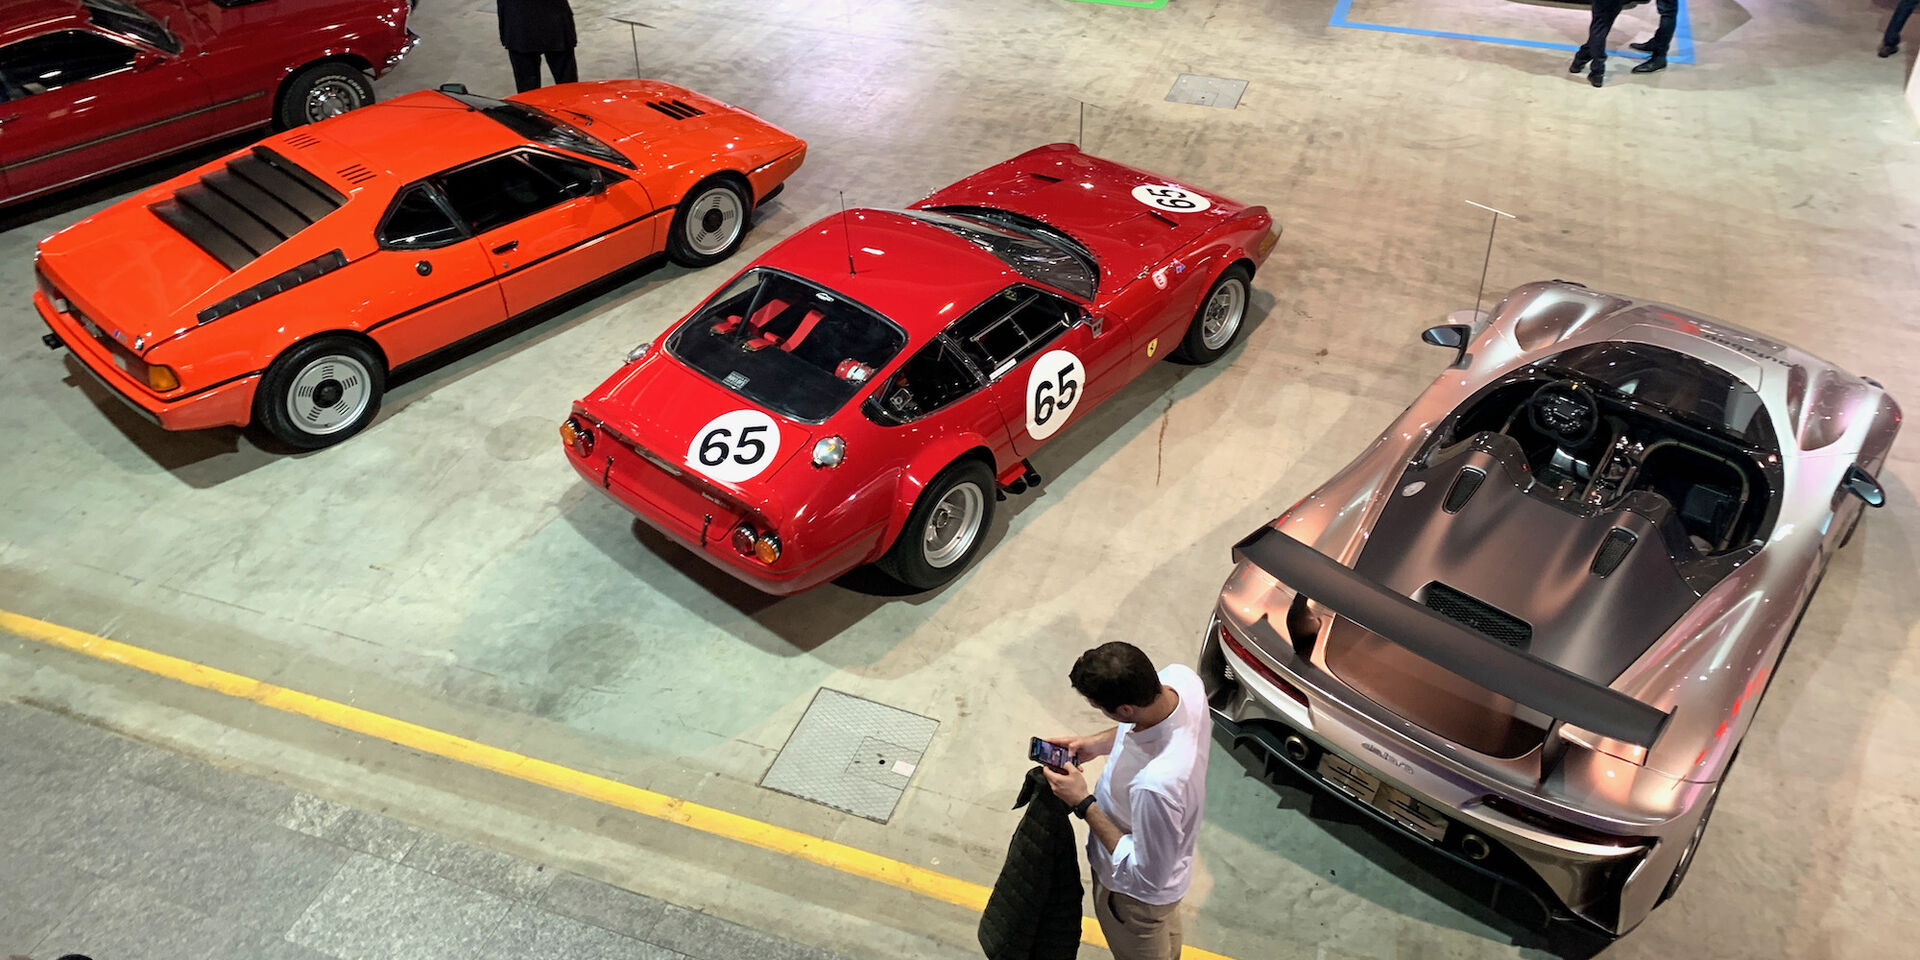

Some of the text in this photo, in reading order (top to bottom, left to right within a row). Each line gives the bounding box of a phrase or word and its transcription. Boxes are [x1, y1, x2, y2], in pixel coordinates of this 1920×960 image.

[1146, 188, 1196, 209] 65
[1034, 362, 1078, 426] 65
[699, 425, 768, 467] 65
